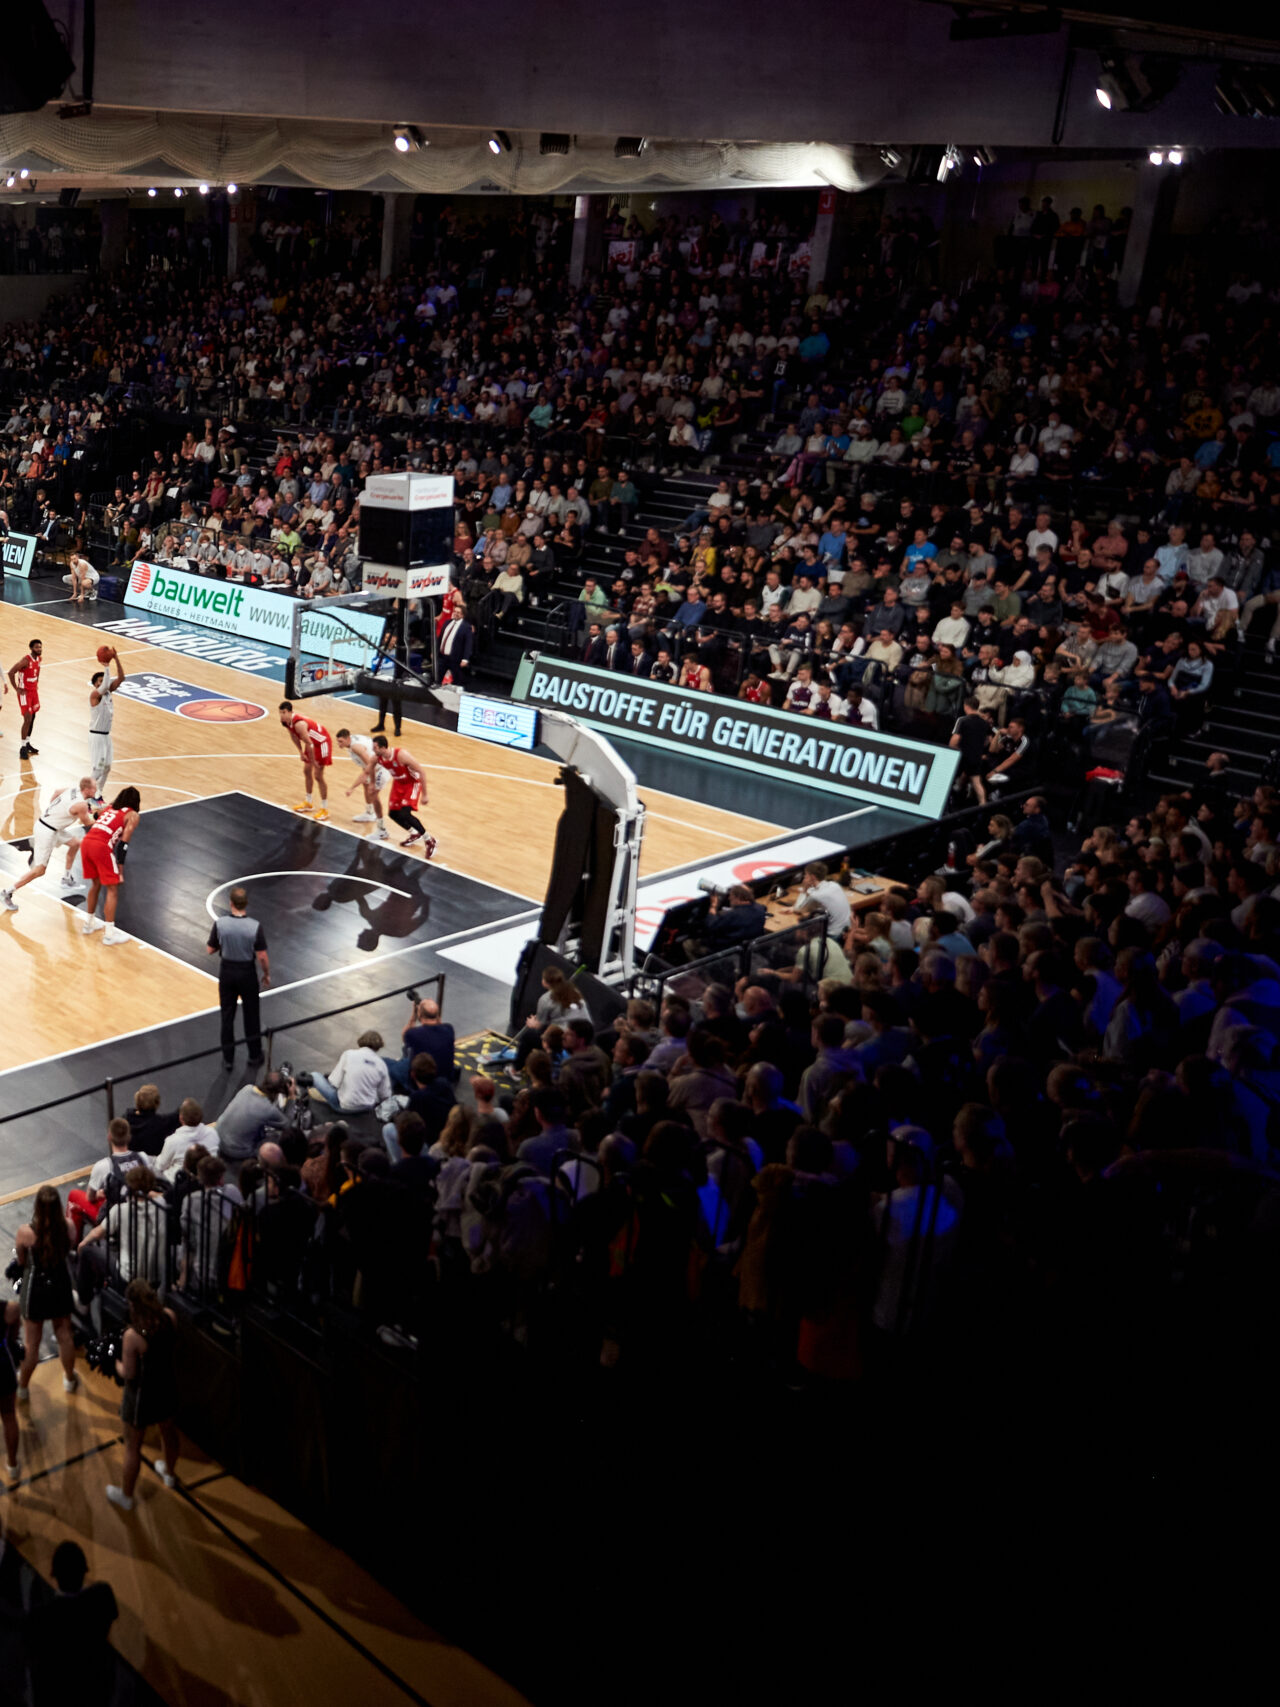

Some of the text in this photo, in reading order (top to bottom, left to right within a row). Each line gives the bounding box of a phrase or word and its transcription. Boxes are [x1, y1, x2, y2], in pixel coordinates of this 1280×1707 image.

[146, 601, 238, 631] DELMES HEITMANN
[150, 569, 245, 618] bauwelt
[249, 605, 381, 650] www.auwelt.eu
[93, 617, 287, 671] HAMBURG
[529, 671, 928, 796] BAUSTOFFE FÜR GENERATIONEN
